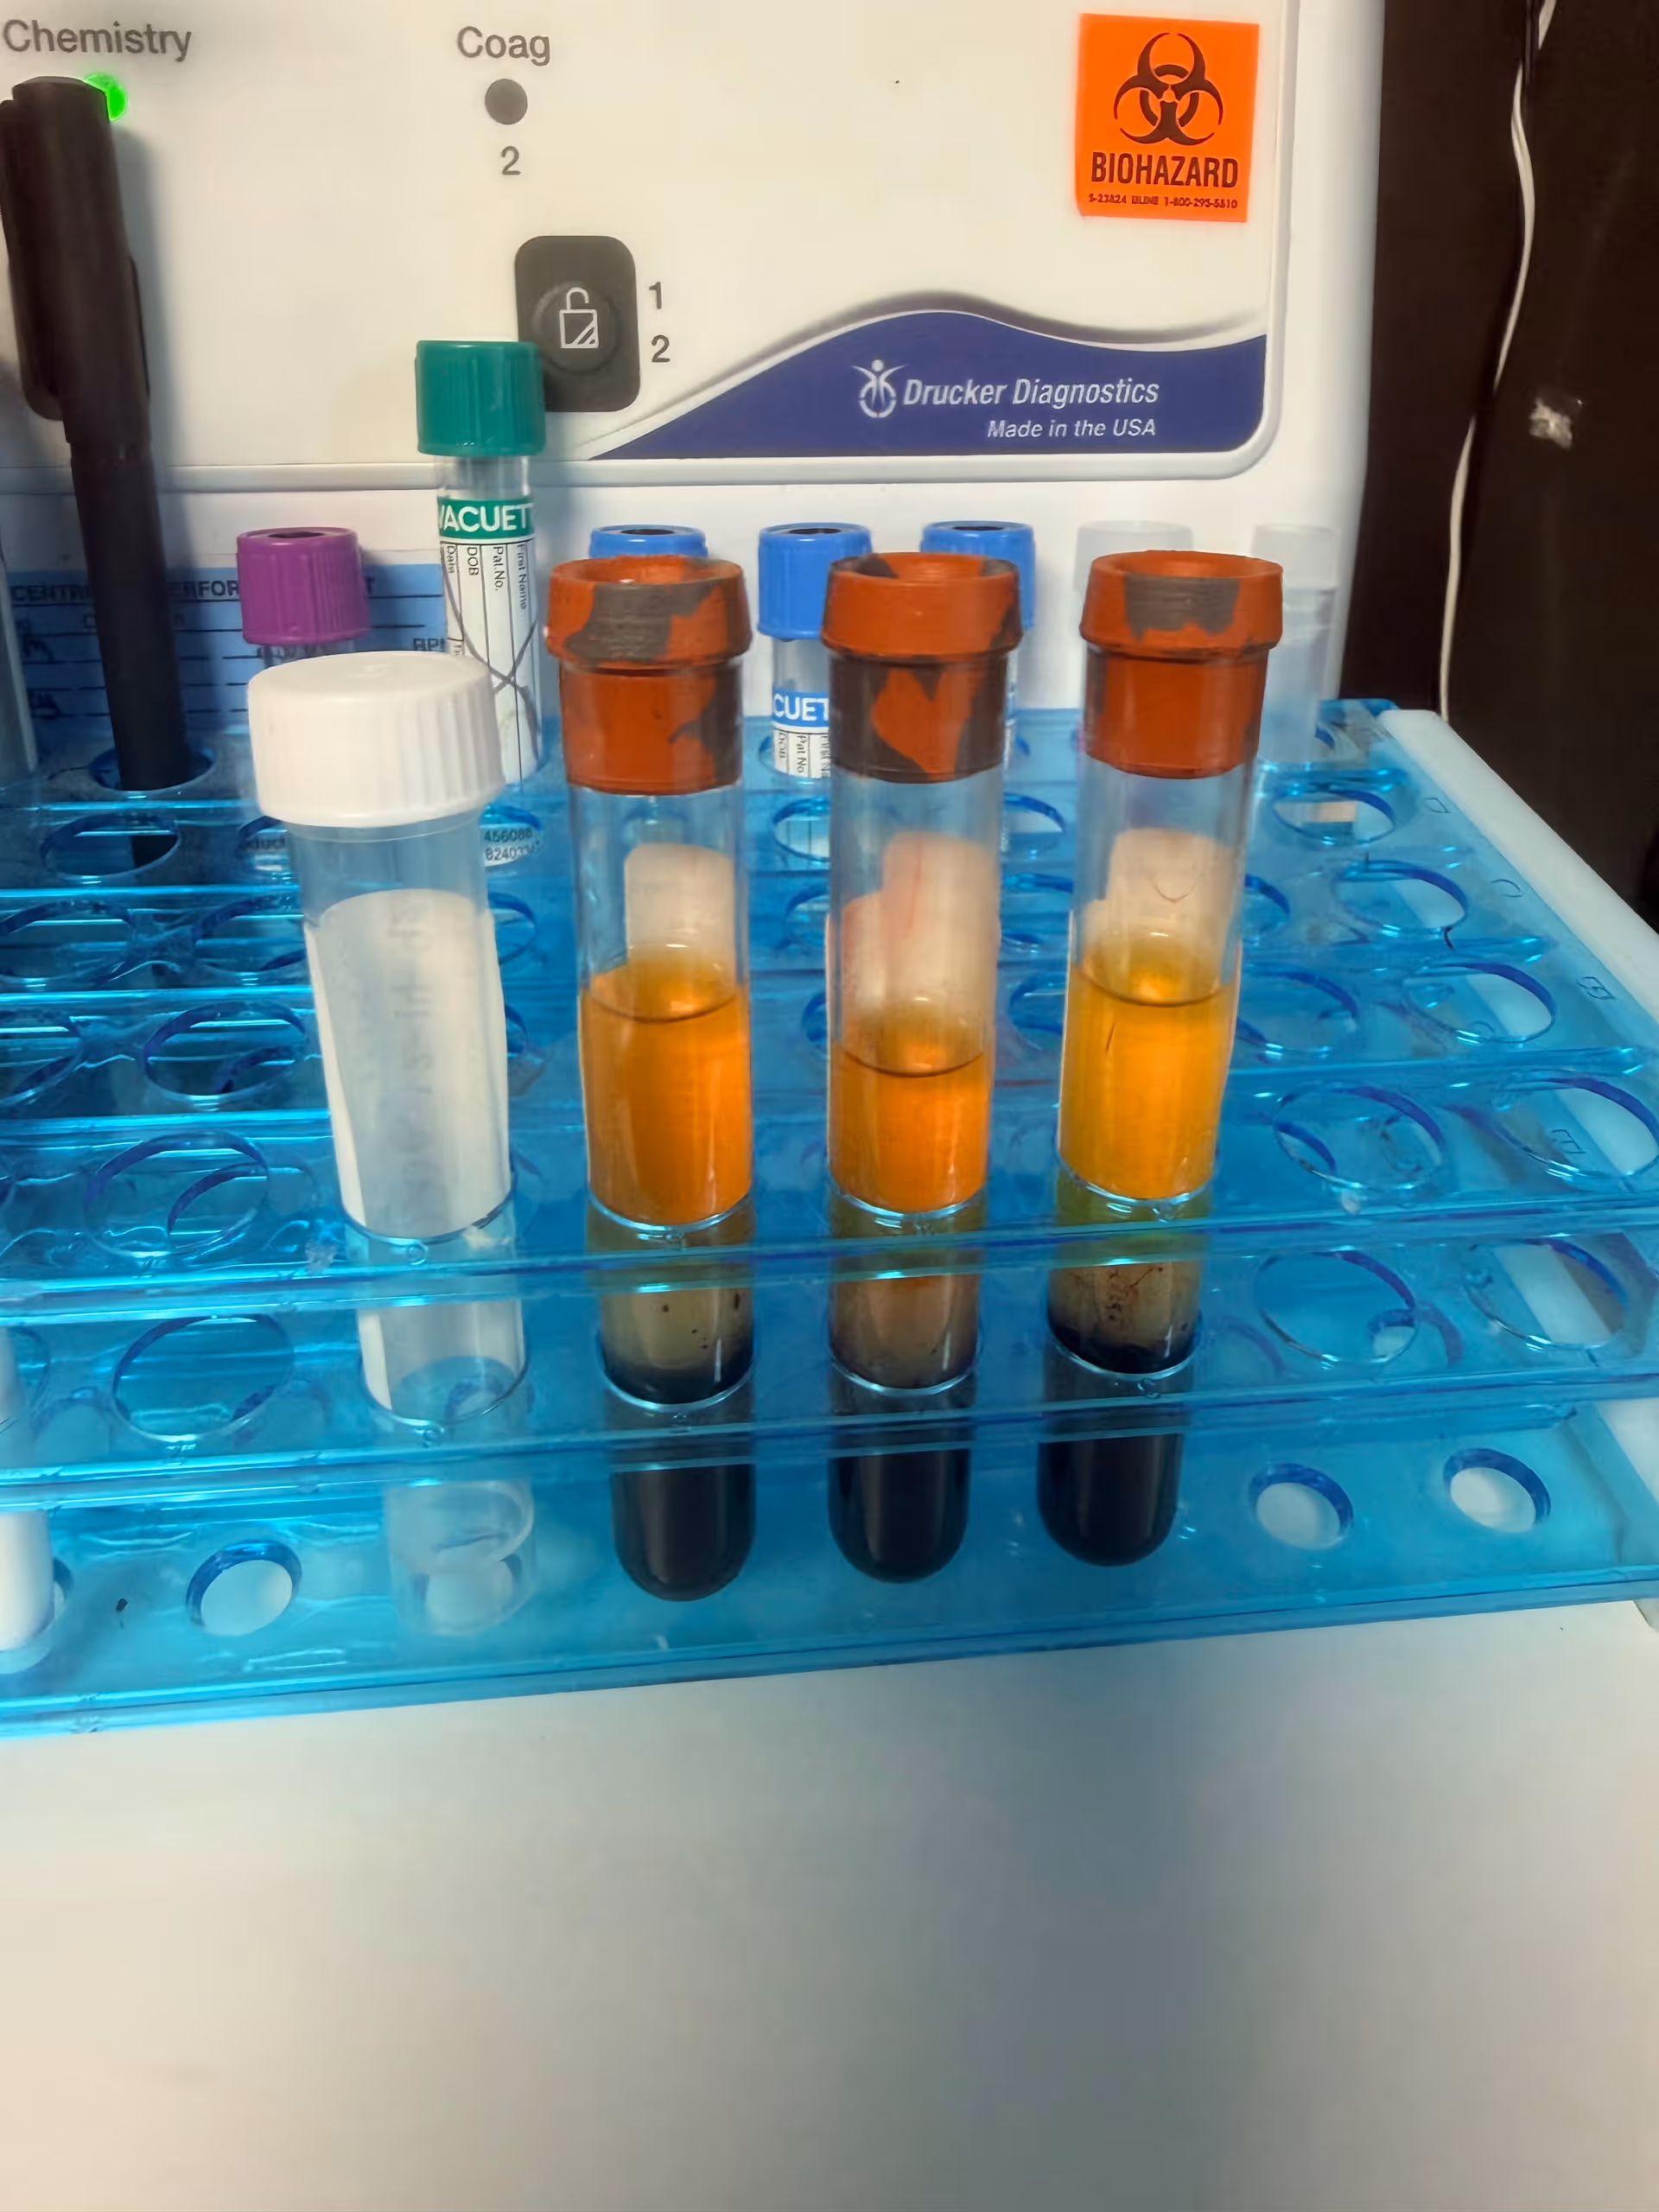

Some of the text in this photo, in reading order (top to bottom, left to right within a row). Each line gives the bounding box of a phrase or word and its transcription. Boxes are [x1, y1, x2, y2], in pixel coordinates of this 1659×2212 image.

[2, 19, 193, 64] Chemistry
[458, 27, 551, 67] Coag
[501, 146, 521, 175] 2
[1091, 151, 1238, 188] BIOHAZARD
[648, 281, 662, 310] 1
[651, 334, 671, 363] 2
[903, 378, 1160, 410] Drucker Diagnostics
[988, 418, 1156, 437] Made in the USA
[467, 546, 480, 576] DOB
